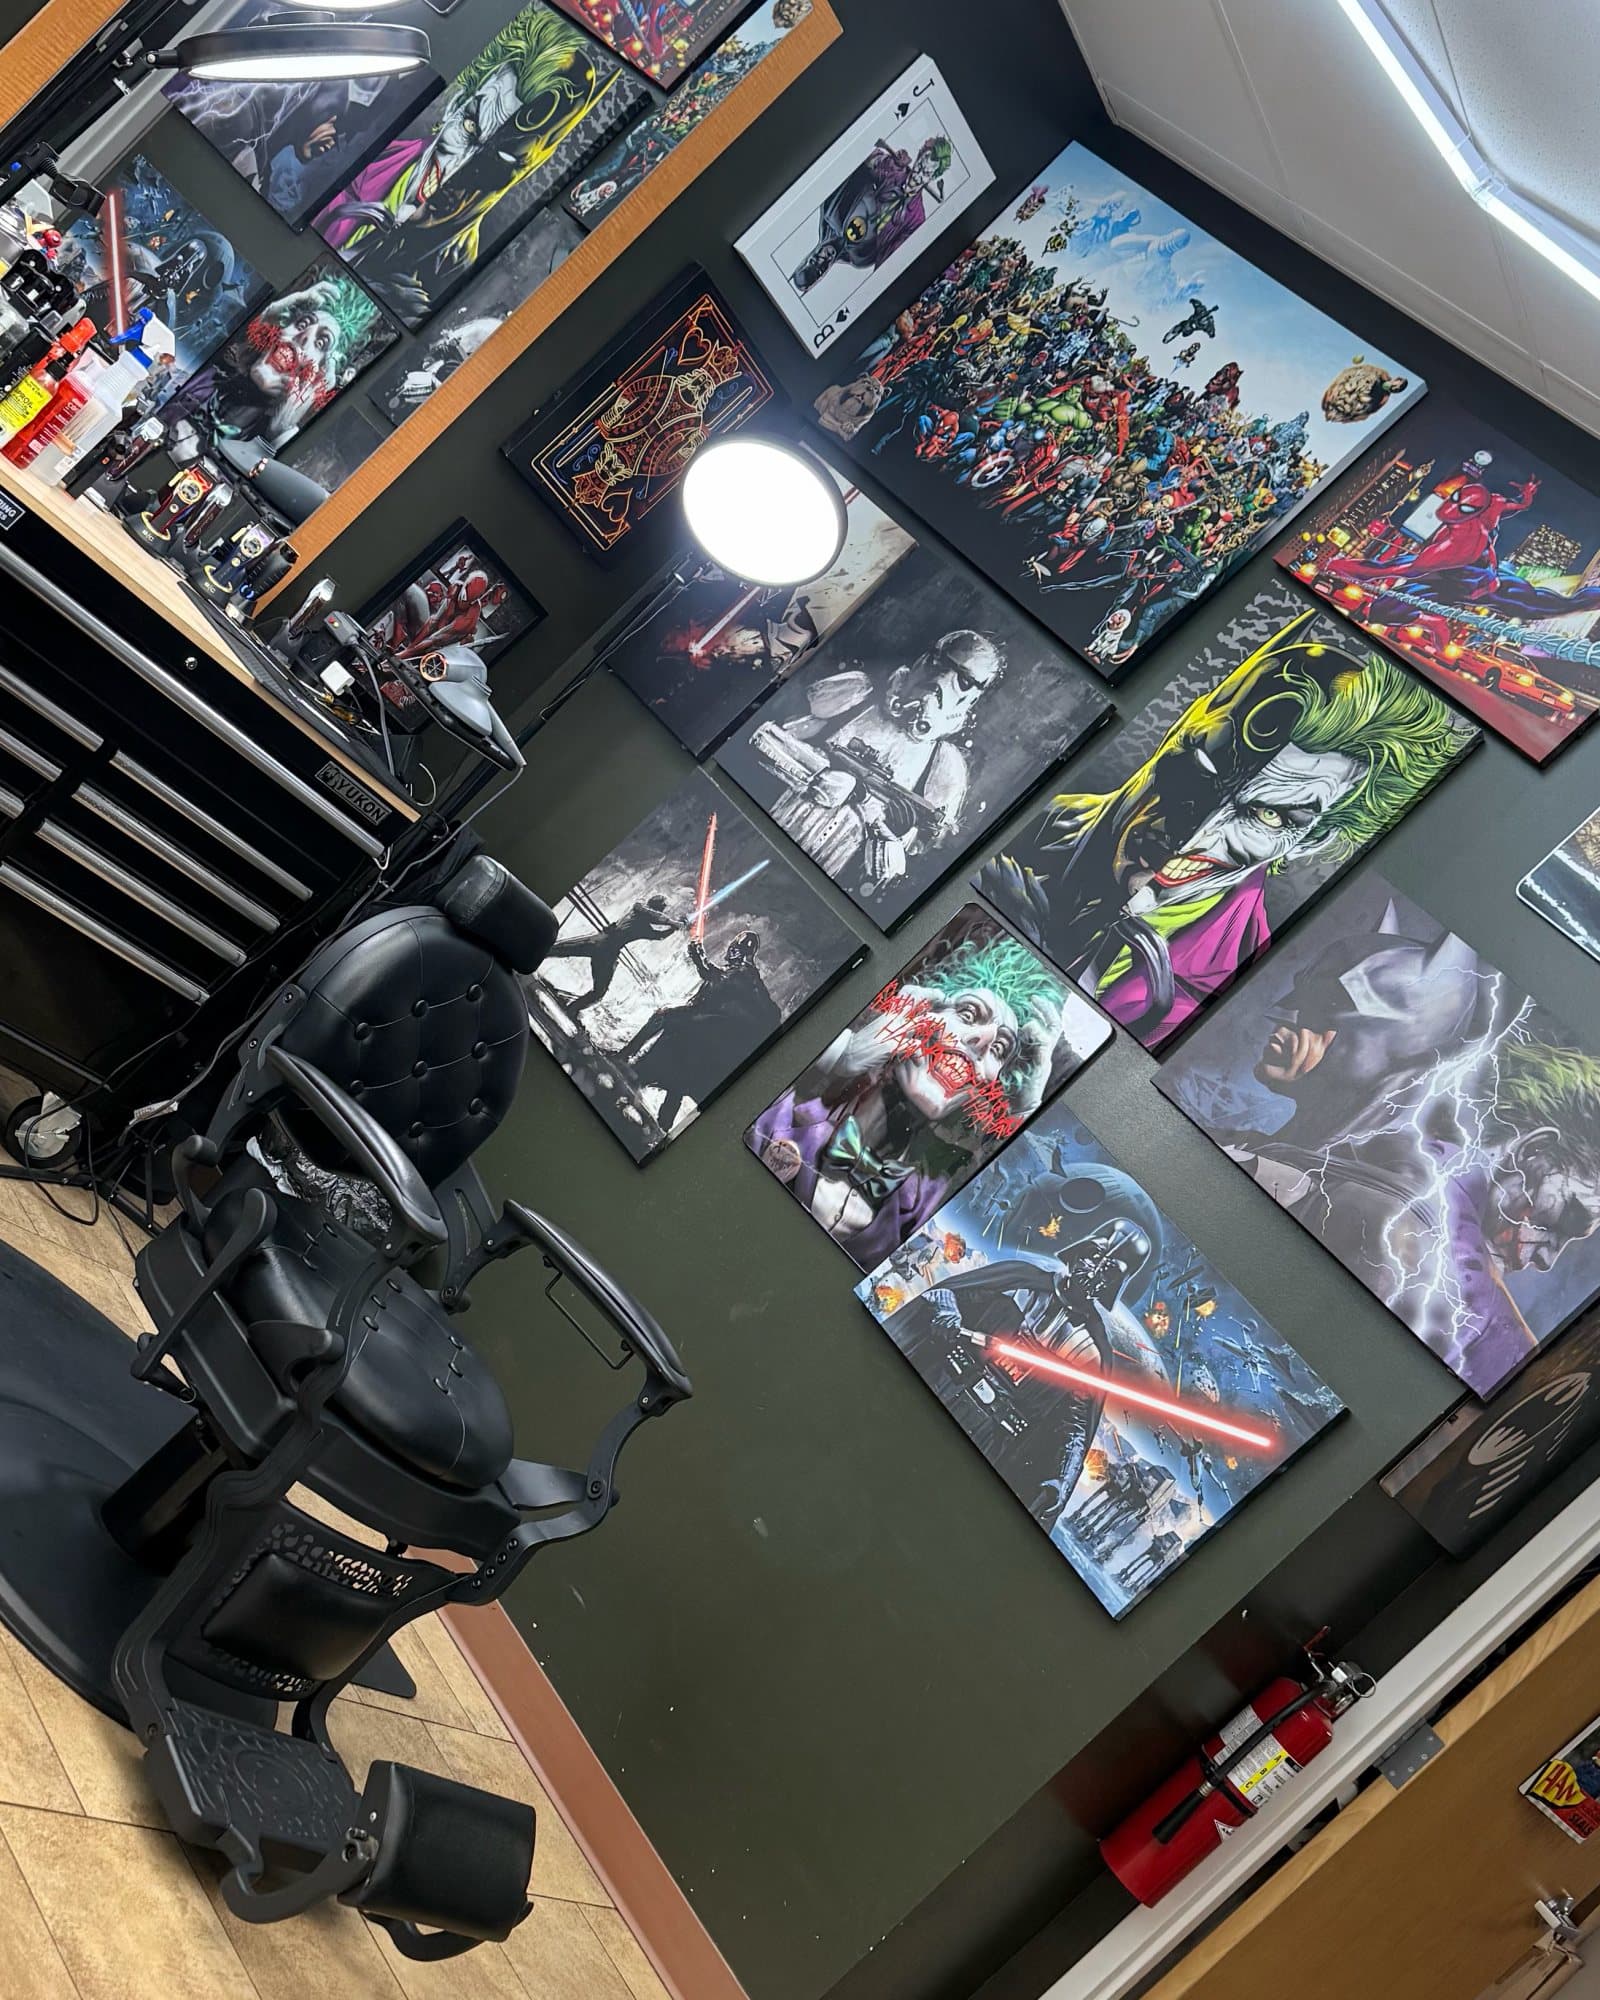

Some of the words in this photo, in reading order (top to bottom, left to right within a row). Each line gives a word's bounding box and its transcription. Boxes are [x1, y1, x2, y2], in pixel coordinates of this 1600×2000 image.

[912, 78, 935, 97] J
[813, 324, 835, 349] B
[336, 779, 386, 821] YUKON
